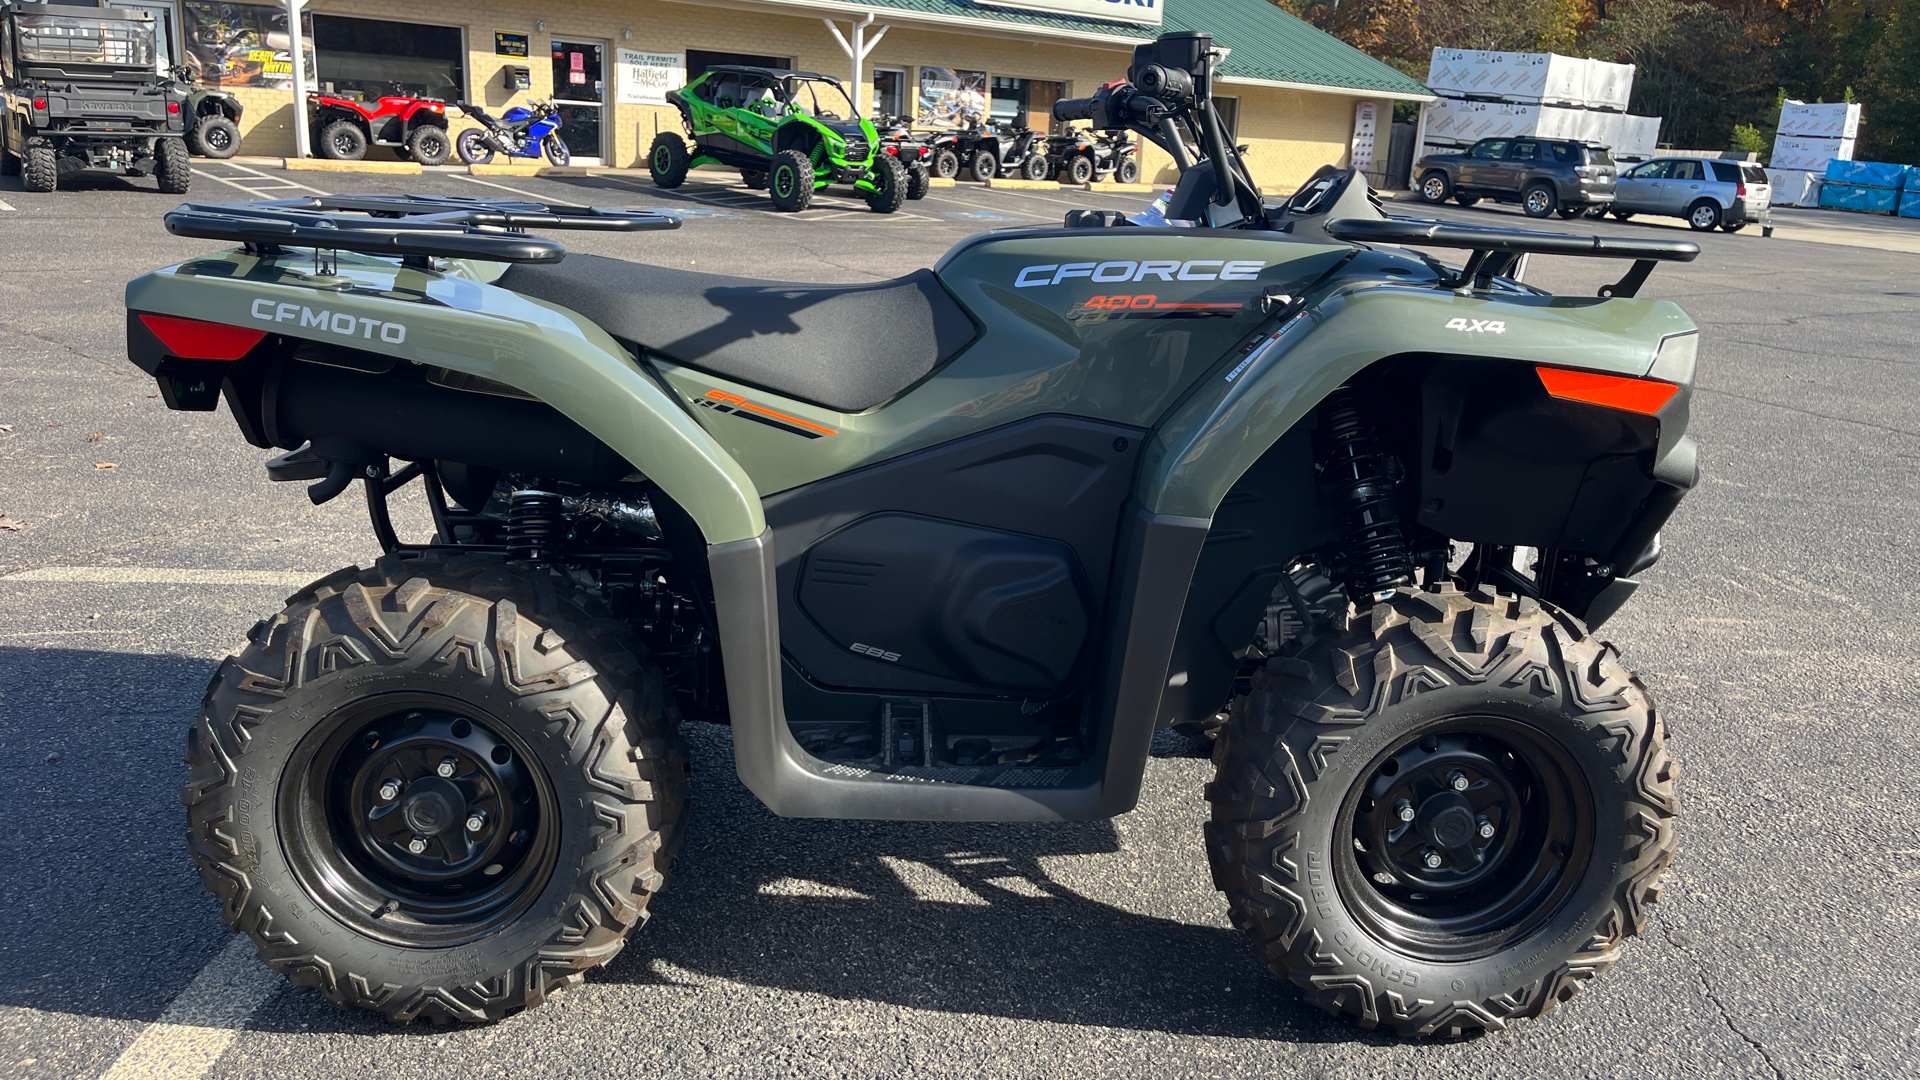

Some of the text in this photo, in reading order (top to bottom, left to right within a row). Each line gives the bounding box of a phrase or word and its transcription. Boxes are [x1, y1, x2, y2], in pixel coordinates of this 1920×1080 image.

[248, 50, 275, 62] READY
[624, 53, 678, 64] TRAIL PERMITS
[262, 61, 292, 74] ANYTHI
[632, 68, 669, 80] Hatfield
[627, 94, 668, 102] TrailsHeaven.c
[81, 101, 135, 111] Kawasaki
[1014, 260, 1265, 288] CFORCE
[1084, 294, 1158, 309] 400
[251, 298, 406, 344] CFMOTO
[705, 389, 747, 405] EFI
[850, 643, 901, 661] EBS
[1334, 929, 1420, 988] CFMOTO
